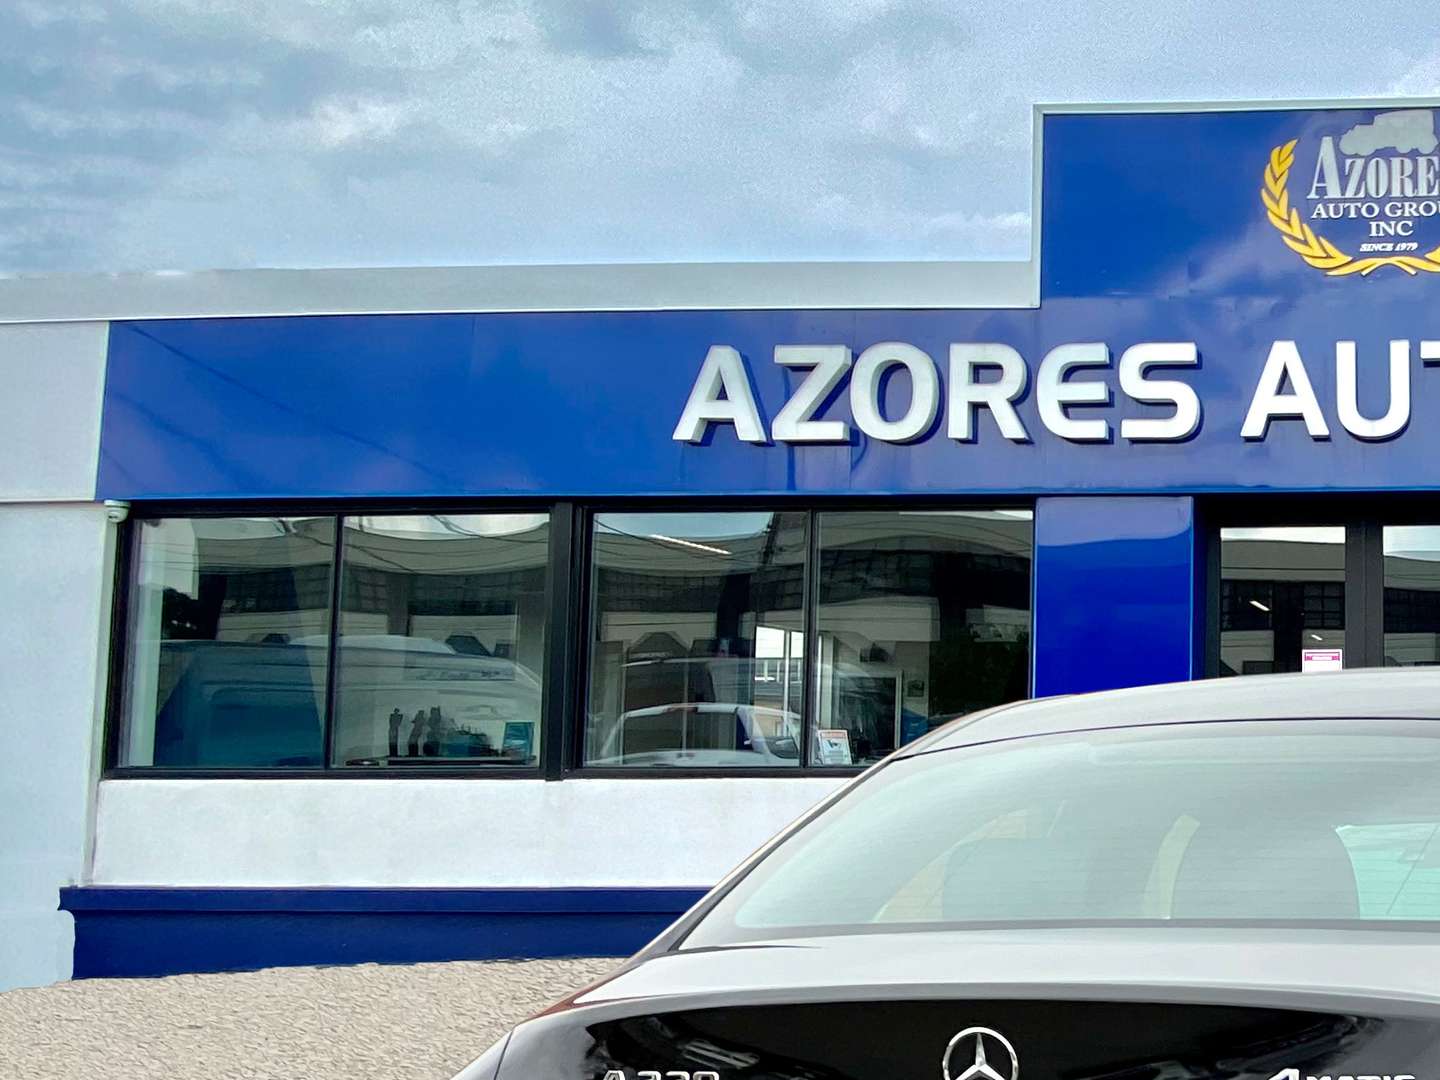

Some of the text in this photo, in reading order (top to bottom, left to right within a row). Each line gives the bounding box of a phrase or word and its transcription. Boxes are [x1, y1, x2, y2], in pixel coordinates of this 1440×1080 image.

[1311, 202, 1379, 219] AUTO
[1369, 221, 1414, 237] INC
[1360, 242, 1418, 252] SINCE 1979
[671, 341, 1200, 445] AZORES
